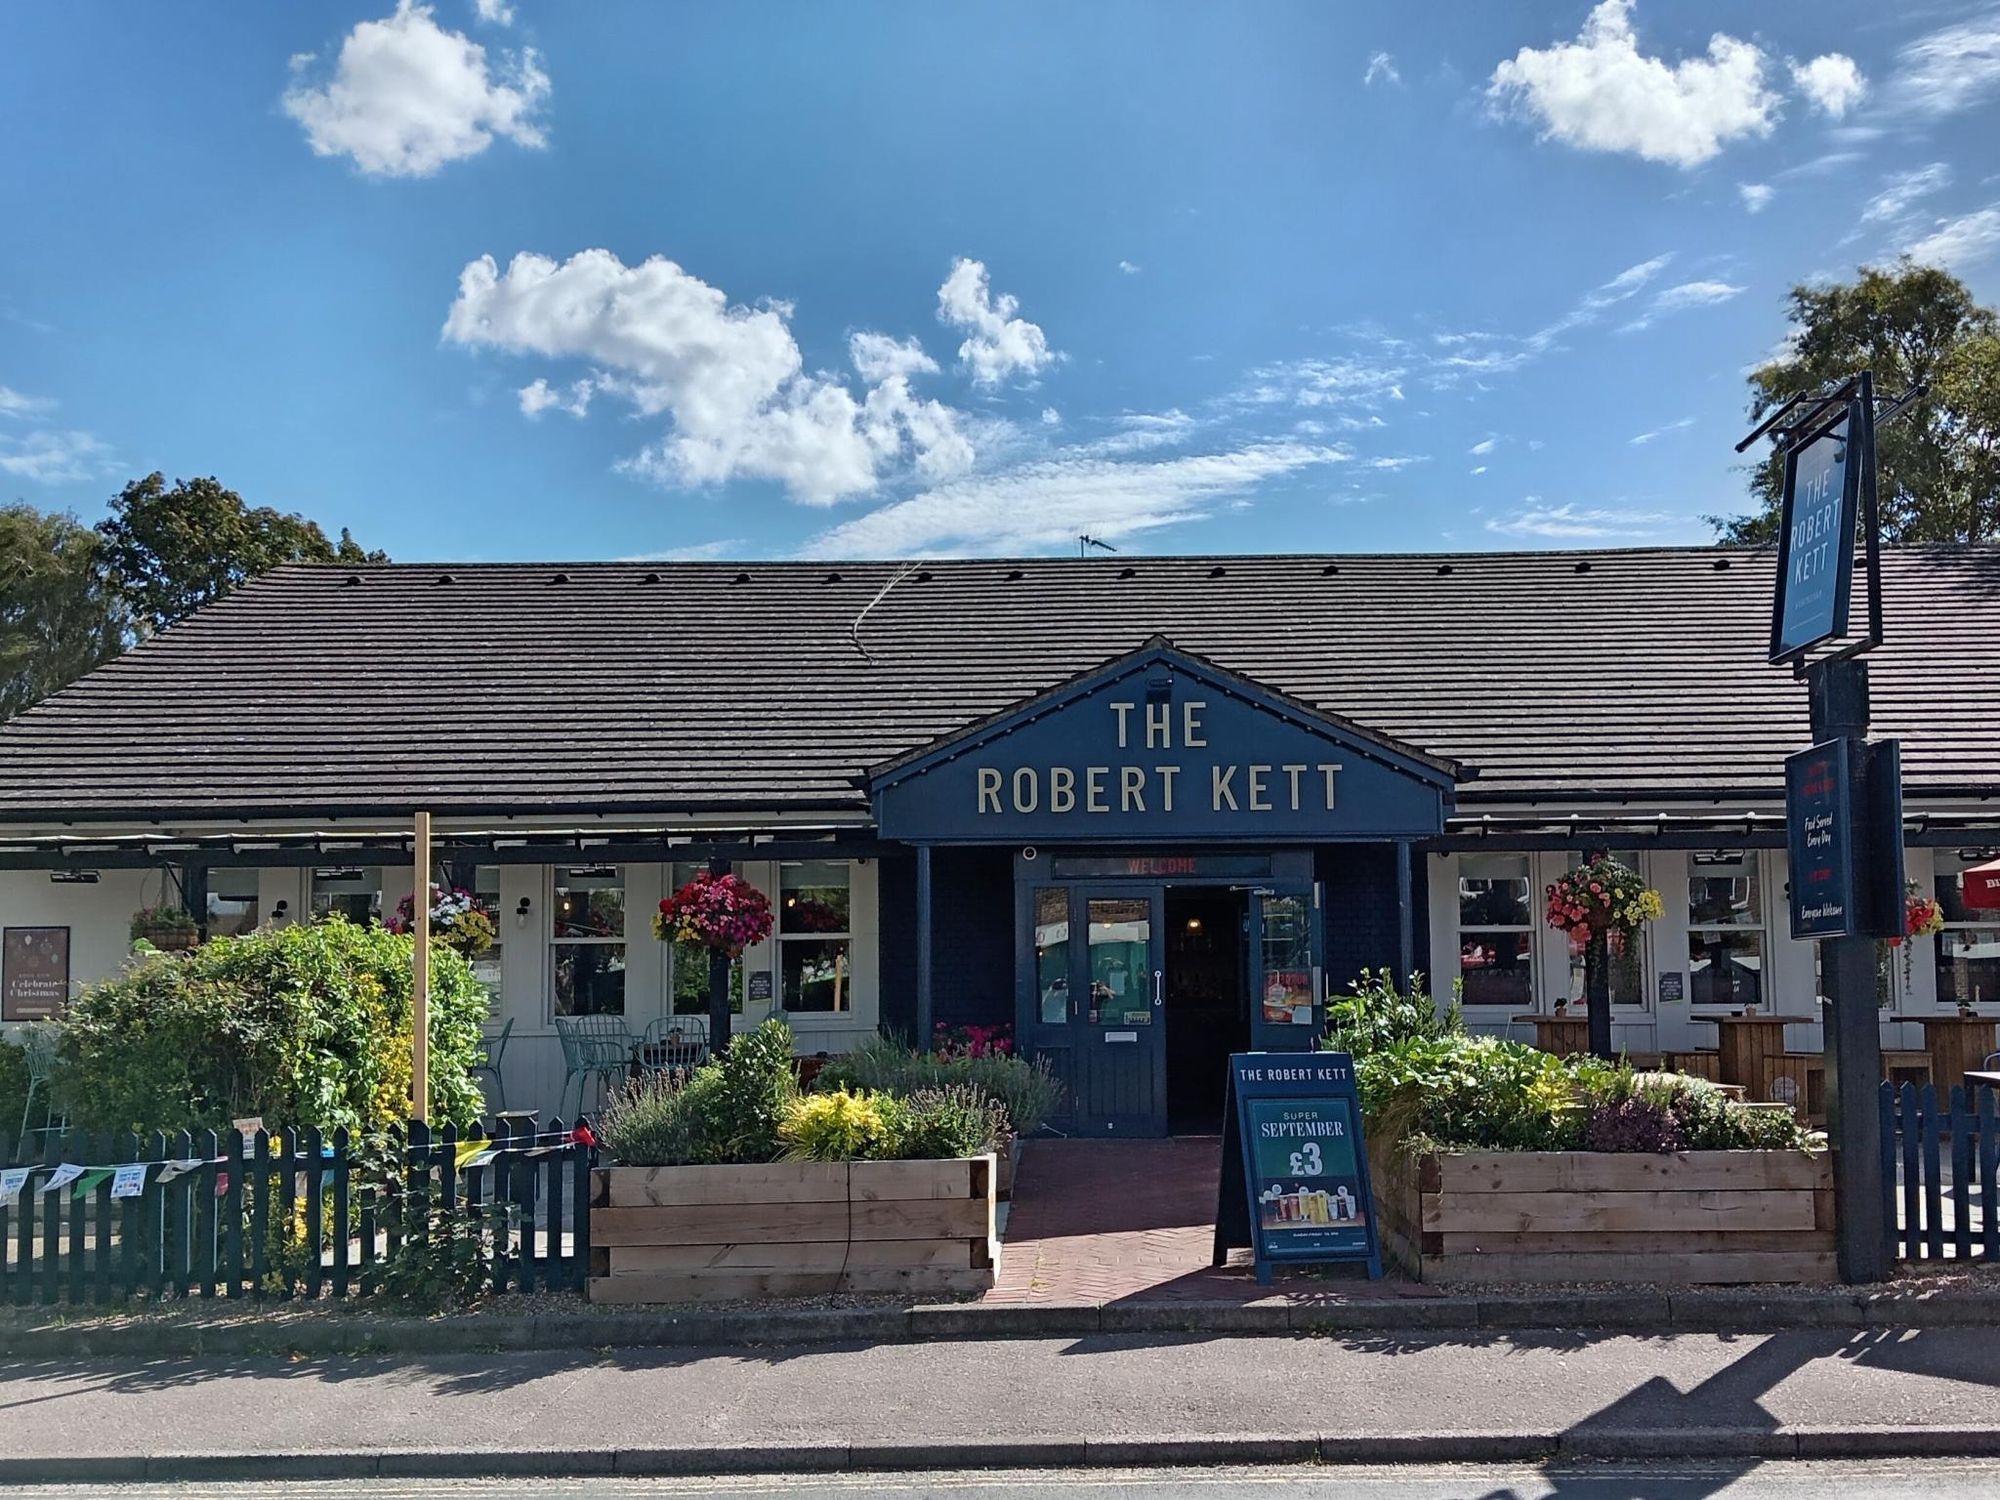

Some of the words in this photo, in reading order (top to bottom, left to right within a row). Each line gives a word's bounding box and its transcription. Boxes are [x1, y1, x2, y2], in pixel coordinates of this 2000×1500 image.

[1806, 468, 1830, 508] THE
[1790, 498, 1840, 553] ROBERT
[1794, 542, 1829, 585] KETT
[1110, 702, 1207, 748] THE
[976, 766, 1181, 814] ROBERT
[1212, 764, 1343, 812] KETT
[1804, 816, 1815, 831] Food
[1815, 811, 1833, 829] Served
[1807, 832, 1821, 848] Every
[1821, 830, 1831, 846] Day
[1127, 857, 1196, 874] WELCOME
[1985, 878, 2000, 888] BI
[1802, 905, 1822, 919] Everyone
[1822, 901, 1843, 917] Welcome
[9, 988, 60, 997] Christmas
[1240, 1069, 1263, 1081] THE
[1267, 1068, 1312, 1081] ROBERT
[1317, 1068, 1347, 1080] KETT
[1283, 1111, 1318, 1121] SUPER
[1261, 1121, 1344, 1137] SEPTEMBER
[1289, 1142, 1323, 1176] £3
